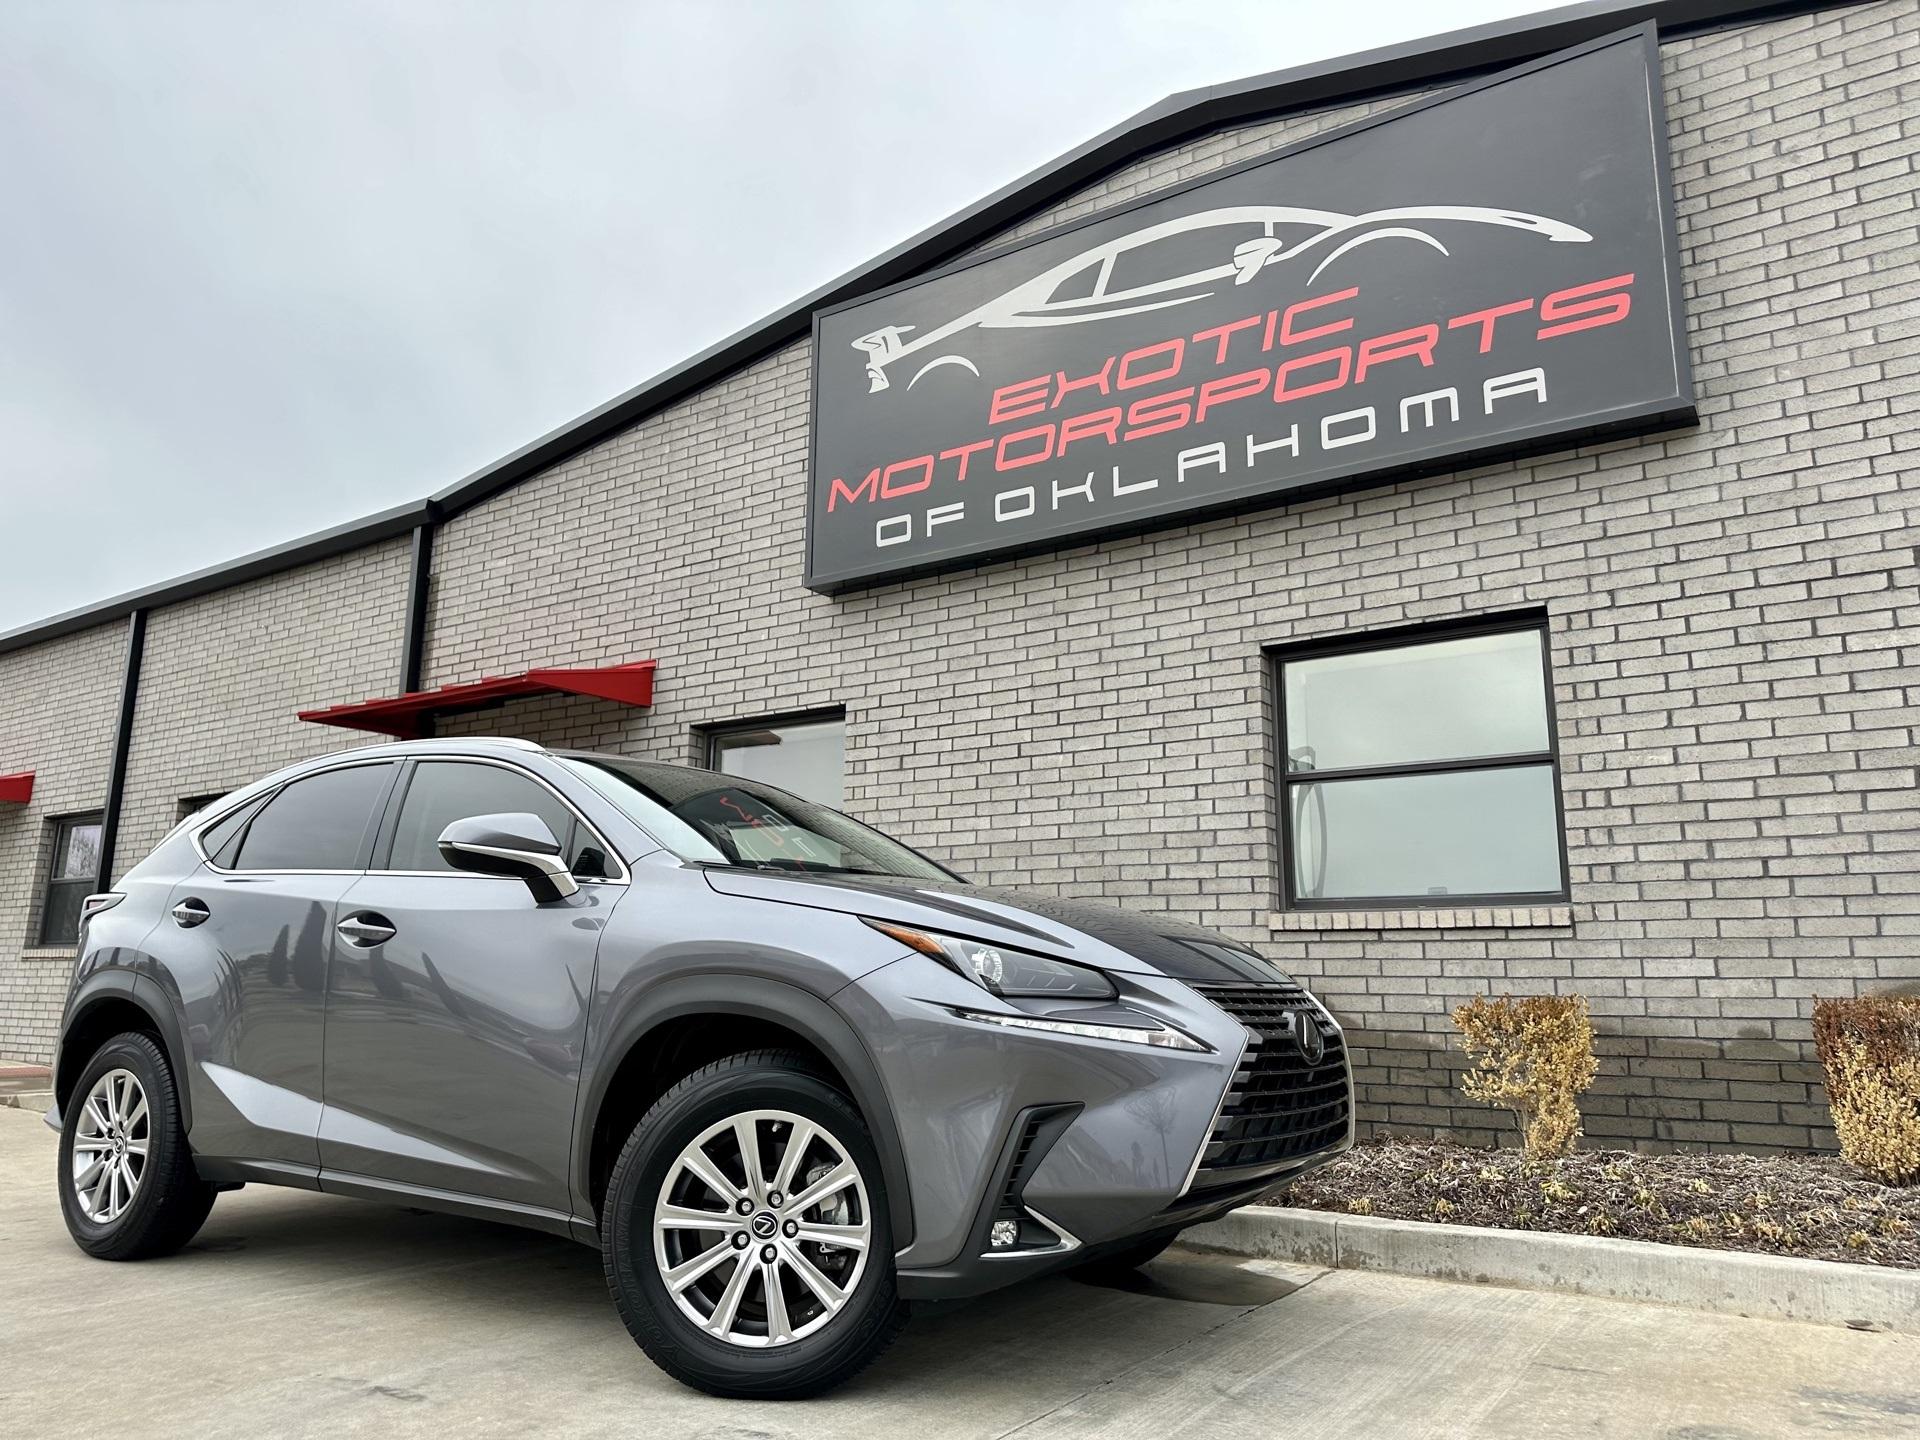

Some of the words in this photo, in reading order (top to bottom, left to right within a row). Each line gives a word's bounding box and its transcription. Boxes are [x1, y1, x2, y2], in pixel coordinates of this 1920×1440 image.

[827, 273, 1635, 513] MOTORSPORTS
[988, 287, 1360, 426] EXOTIC
[875, 501, 966, 548] OF
[994, 367, 1548, 523] OKLAHOMA
